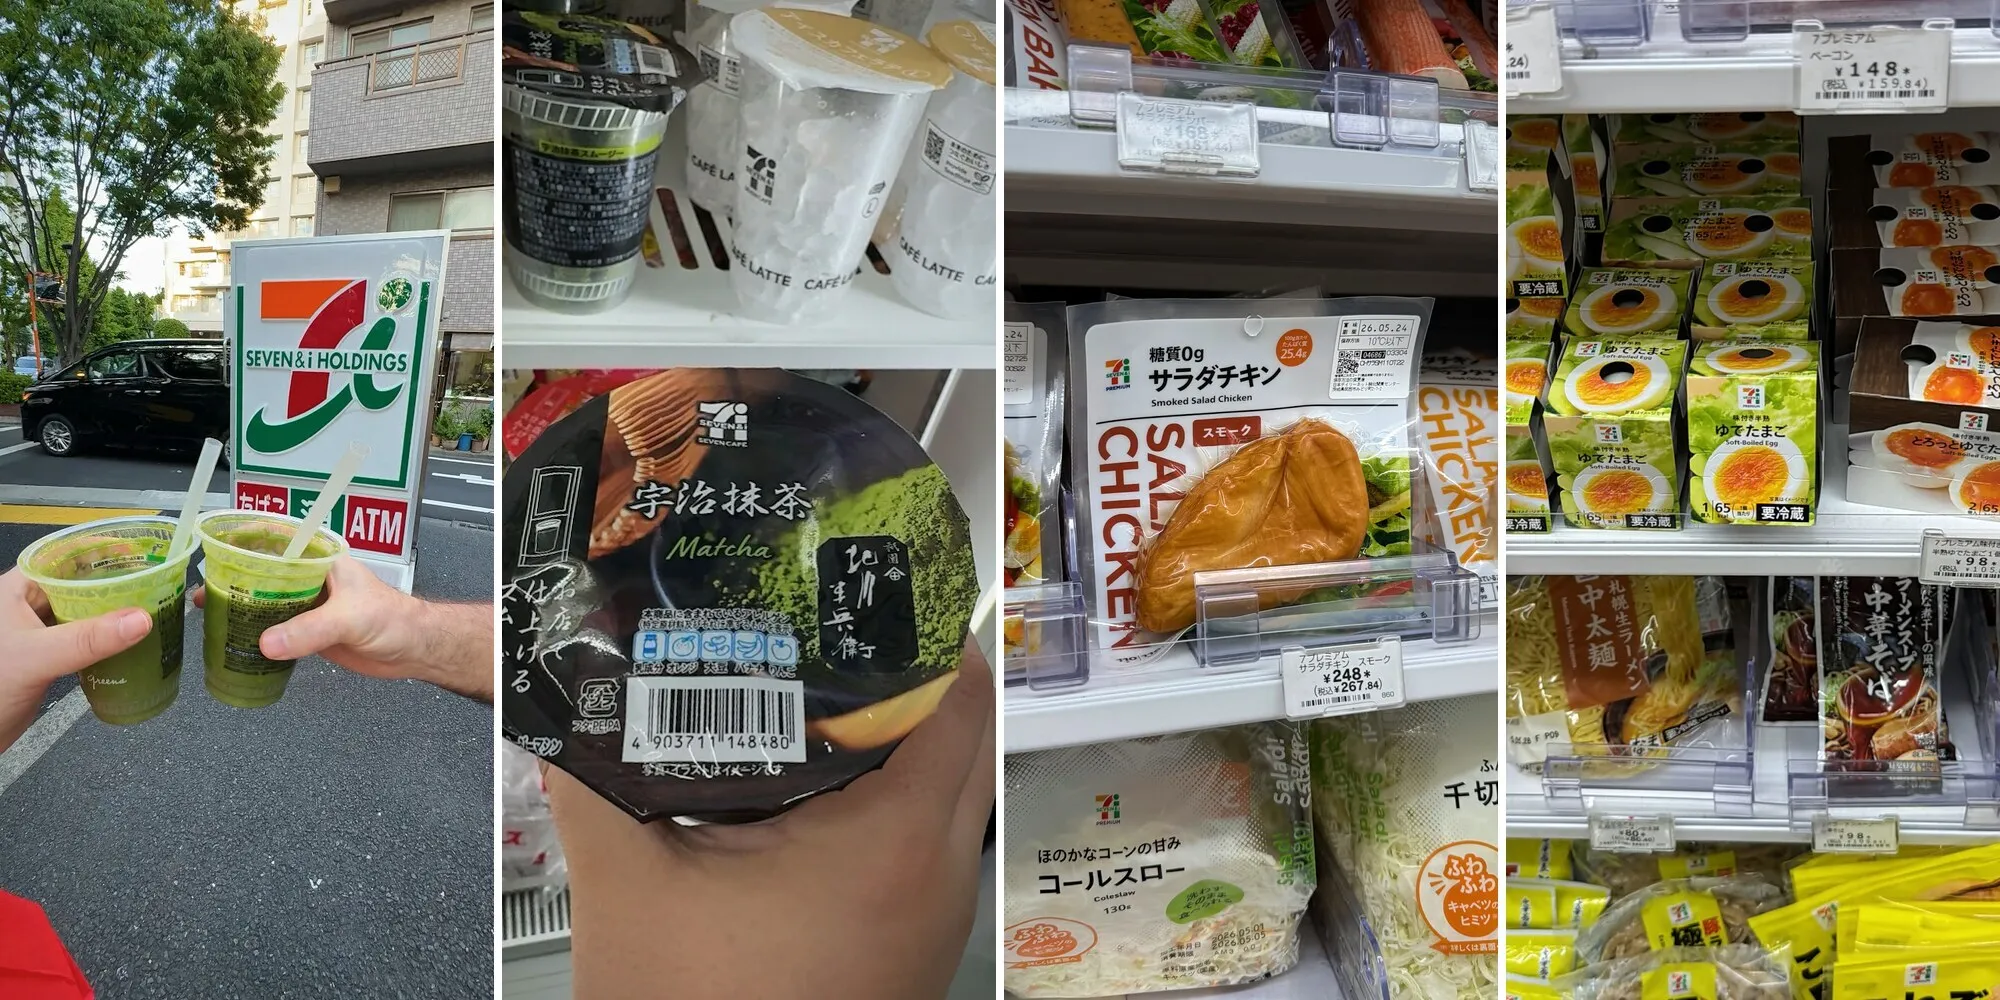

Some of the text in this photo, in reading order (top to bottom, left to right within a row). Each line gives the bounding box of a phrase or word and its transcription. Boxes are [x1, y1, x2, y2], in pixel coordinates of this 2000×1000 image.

[1812, 33, 1876, 45] 7プレミアム
[1810, 51, 1854, 61] ベーコン
[1678, 217, 1737, 225] ゆでたまご
[749, 260, 793, 288] LATTE
[922, 257, 965, 283] LATTE
[1739, 266, 1803, 275] ゆでたまご
[804, 274, 841, 291] CAFÉ
[1519, 281, 1560, 296] 要冷蔵
[1614, 275, 1680, 285] ゆでたまご
[1361, 323, 1407, 333] 26.05.24
[1149, 346, 1205, 363] 糖質0g
[1280, 348, 1308, 360] 25.4g
[1605, 346, 1671, 356] ゆでたまご
[317, 352, 408, 372] HOLDINGS
[1149, 364, 1281, 393] サラダチキン
[1151, 394, 1253, 407] Smoked Salad Chicken
[1203, 424, 1253, 439] スモーク
[1715, 424, 1788, 438] ゆでたまご
[698, 437, 726, 447] SEVEN
[1578, 453, 1648, 464] ゆでたまご
[1146, 423, 1188, 533] SAL
[1419, 386, 1489, 565] CHICKEN
[629, 480, 814, 521] 宇治抹茶
[1702, 502, 1731, 513] 1 65
[1968, 501, 1999, 513] 2 65
[1630, 515, 1672, 527] 要冷蔵
[1761, 505, 1805, 520] 要冷蔵
[349, 506, 402, 546] ATM
[1098, 425, 1142, 651] CHICKEN
[665, 534, 773, 560] Matcha
[641, 608, 791, 624] 本商品に含まれているアレルゲン
[510, 579, 546, 694] 仕上げる
[1577, 584, 1619, 673] 中太麺
[1608, 579, 1642, 692] 札幌生ラーメン
[1864, 583, 1894, 703] 中華そば
[1299, 650, 1350, 664] 7プレミアム
[1299, 655, 1391, 674] サラダチキン スモーク
[633, 662, 798, 679] 乳成分 オレンジ 大豆 バナナ りんご
[1313, 678, 1383, 697] (税込¥267.84)
[632, 735, 790, 751] 4 903711 148480
[641, 763, 787, 780] 写真・イラストはイメージです。
[1267, 738, 1292, 805] Salad!
[1038, 836, 1182, 865] ほのかなコーンの甘み
[1448, 858, 1484, 877] ふわ
[1038, 864, 1186, 895] コールスロー
[1460, 876, 1496, 894] ふわ
[1093, 890, 1136, 903] Coleslaw
[1460, 914, 1491, 927] ヒミツ
[1211, 922, 1265, 944] 2026.05.01
[1212, 932, 1267, 950] 2026.05.05
